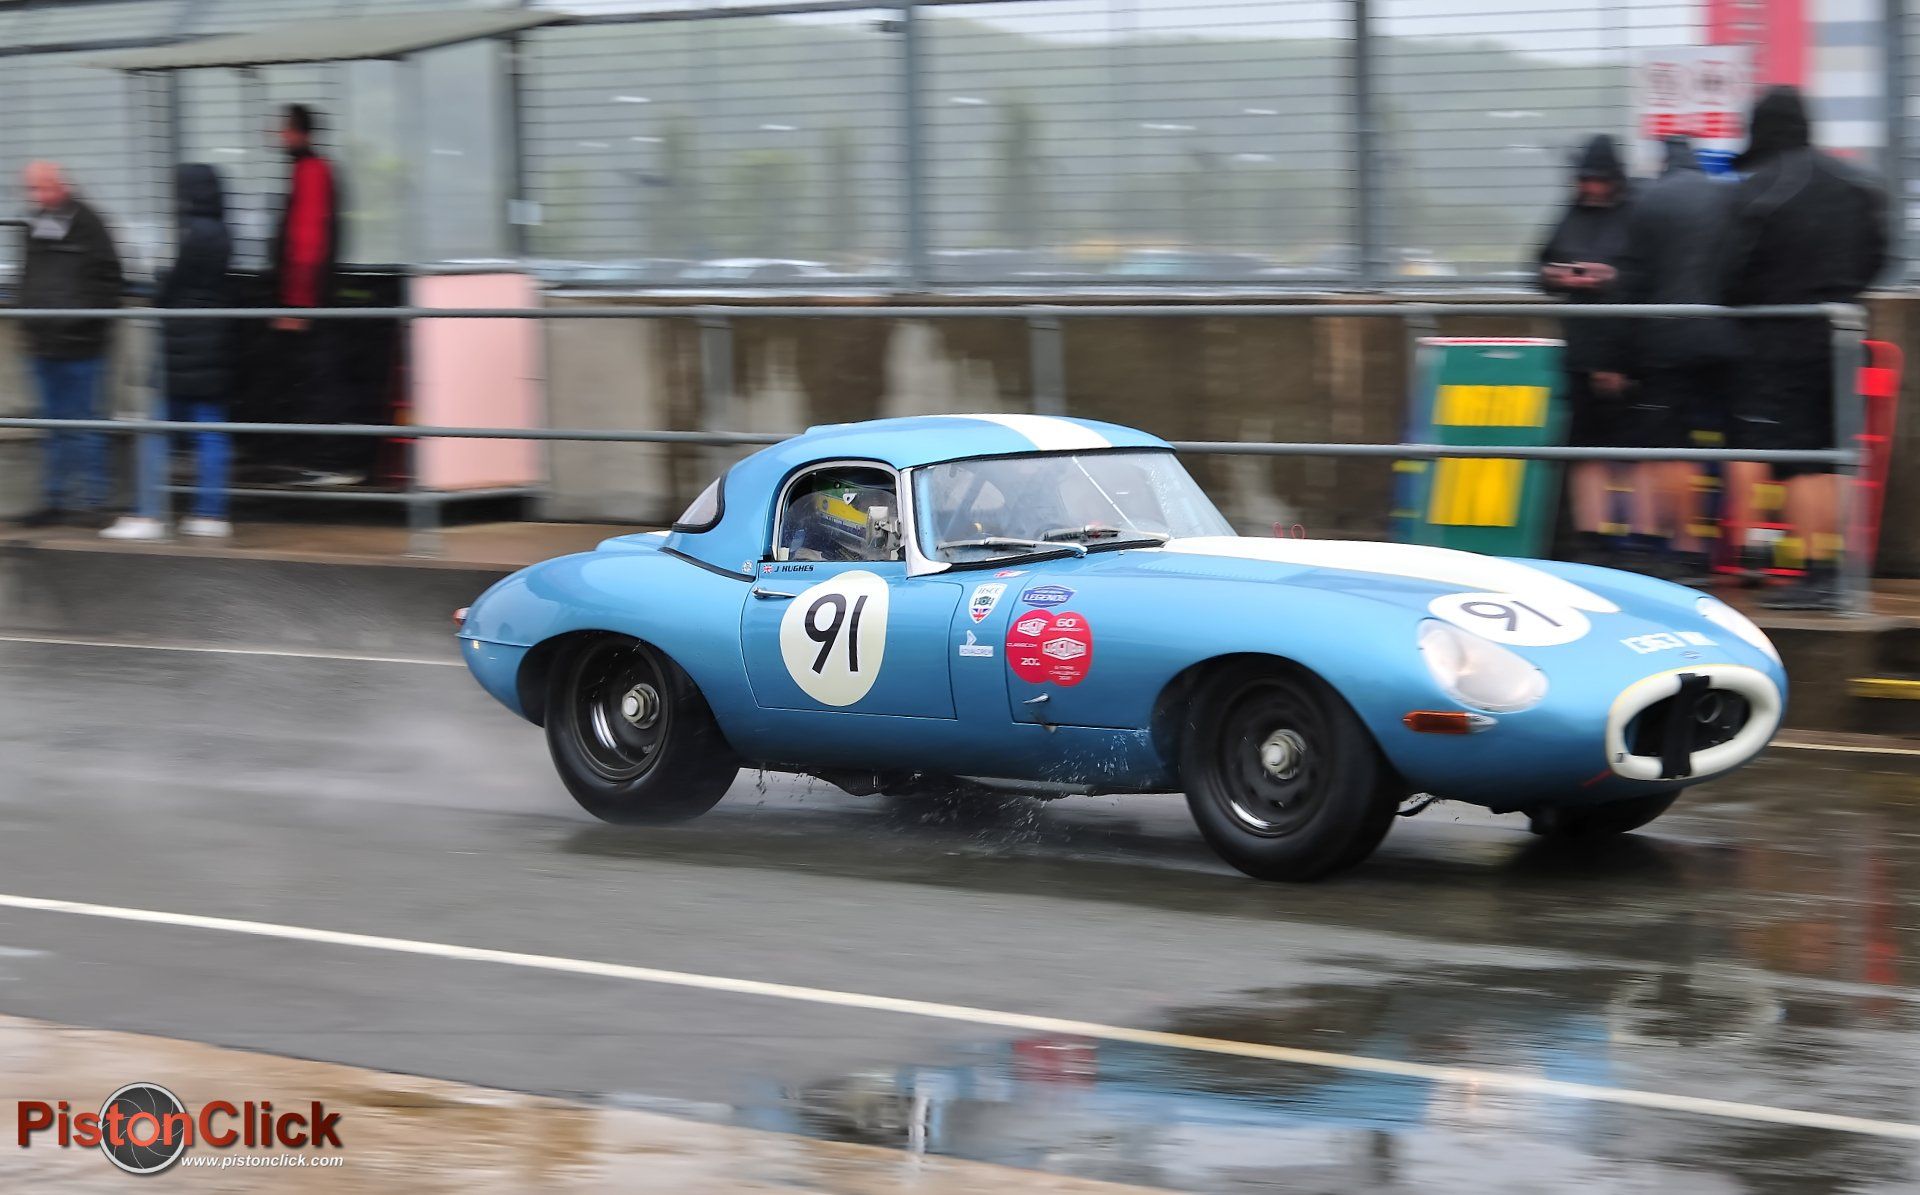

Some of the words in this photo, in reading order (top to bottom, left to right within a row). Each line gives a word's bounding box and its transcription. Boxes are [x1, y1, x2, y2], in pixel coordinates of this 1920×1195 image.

[774, 565, 781, 573] J
[781, 564, 815, 573] HUGHES
[1023, 593, 1069, 602] LEGENDS
[1460, 600, 1563, 632] 91
[804, 593, 869, 675] 91
